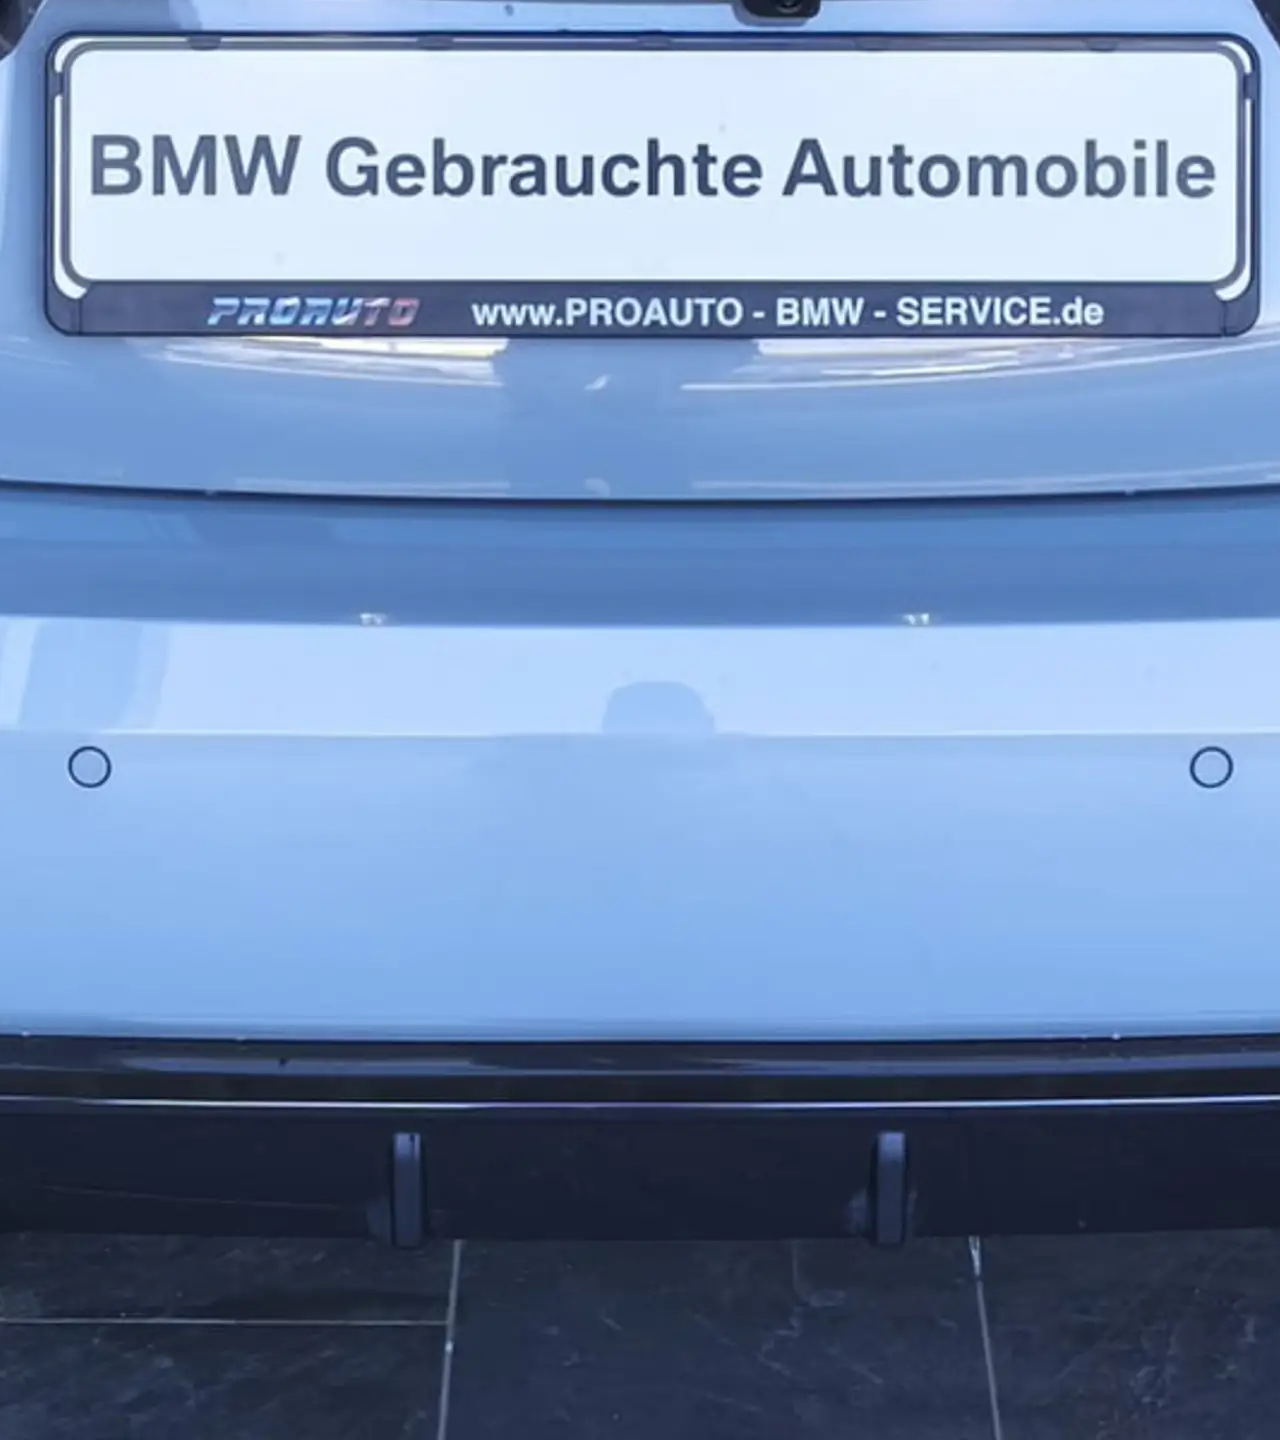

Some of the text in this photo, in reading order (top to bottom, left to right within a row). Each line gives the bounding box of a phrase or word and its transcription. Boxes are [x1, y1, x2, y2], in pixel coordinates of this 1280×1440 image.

[90, 133, 1216, 199] BMW Gebrauchte Automobile
[471, 297, 743, 327] www.PROAUTO
[776, 297, 865, 327] BMW
[896, 296, 1105, 327] SERVICE.de
